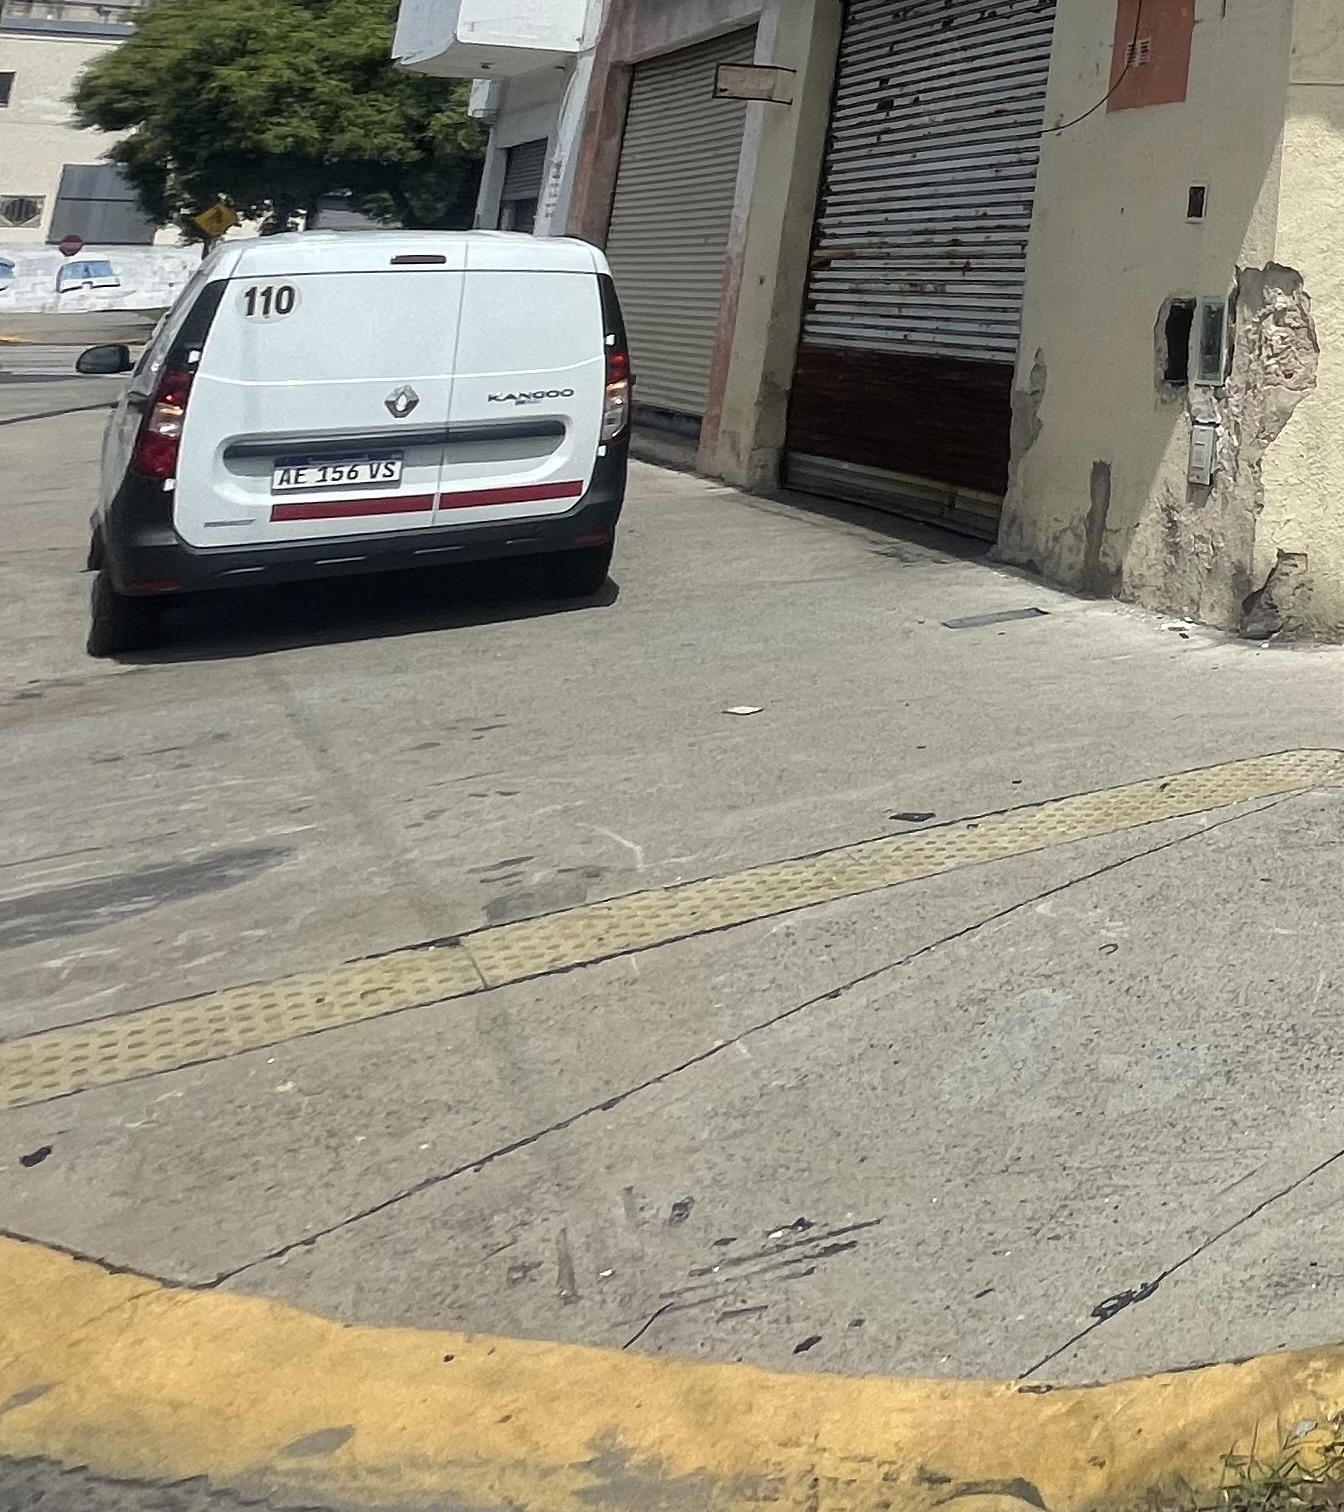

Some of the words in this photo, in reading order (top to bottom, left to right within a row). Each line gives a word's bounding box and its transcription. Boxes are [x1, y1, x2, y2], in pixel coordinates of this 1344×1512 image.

[244, 285, 296, 316] 110
[487, 389, 574, 402] KANGOO
[278, 468, 307, 486] AE
[315, 464, 361, 483] 156
[368, 461, 396, 479] VS
